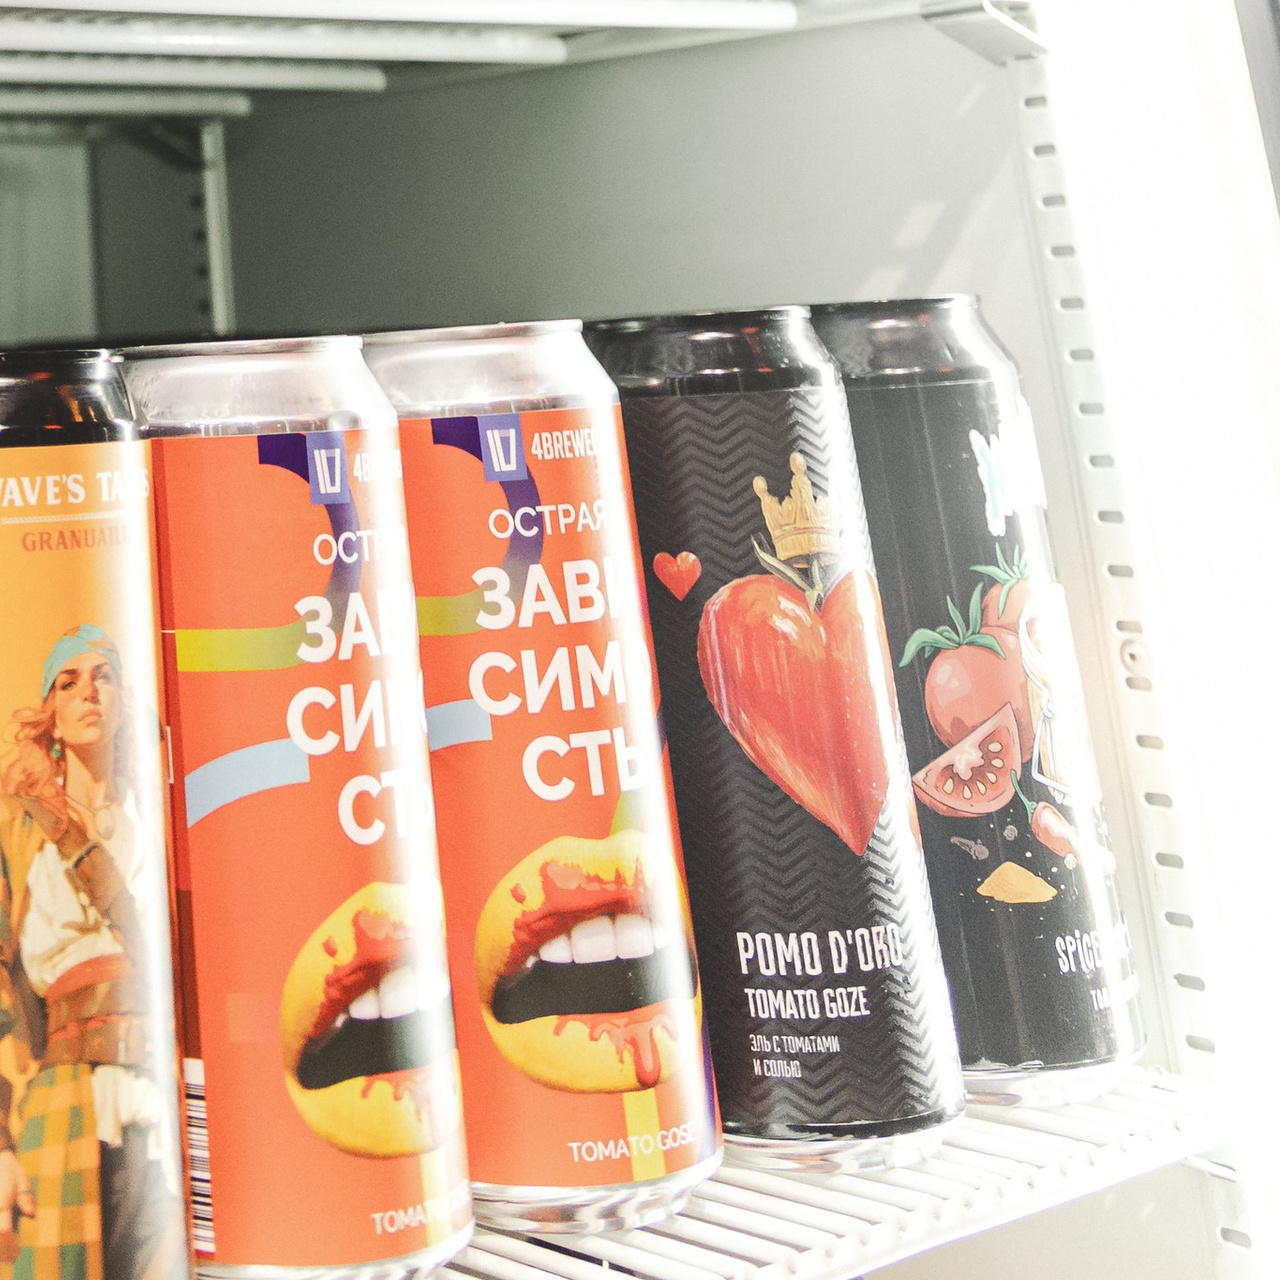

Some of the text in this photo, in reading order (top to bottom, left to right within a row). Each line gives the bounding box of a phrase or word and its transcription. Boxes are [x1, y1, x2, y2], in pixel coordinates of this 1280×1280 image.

[488, 500, 610, 539] ОСТРАЯ
[522, 727, 650, 801] СТЬ
[736, 922, 903, 976] POMO D'ORO
[744, 986, 871, 1019] TOMATO GOZE
[750, 1034, 840, 1053] ЭЛЬ С ТОМАТАМИ
[753, 1059, 802, 1079] И СОЛЬЮ
[568, 1123, 697, 1164] TOMATO GOSE
